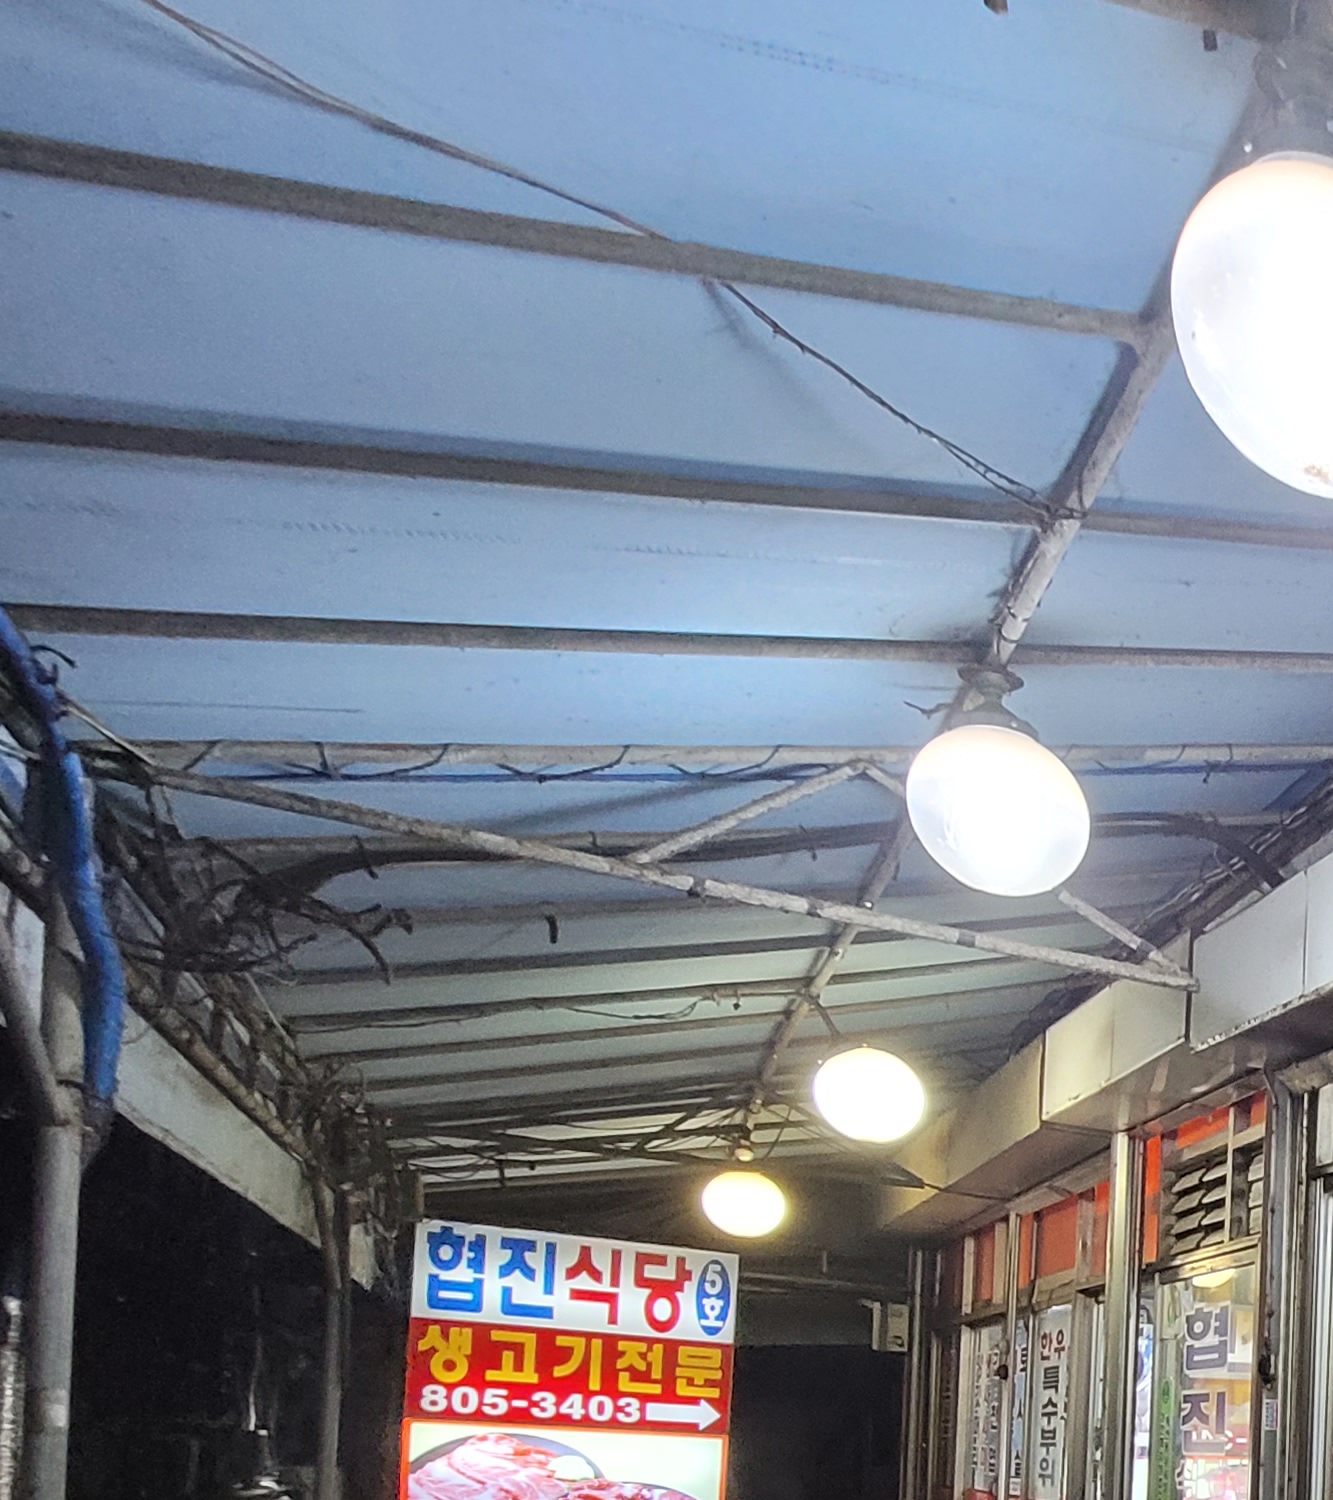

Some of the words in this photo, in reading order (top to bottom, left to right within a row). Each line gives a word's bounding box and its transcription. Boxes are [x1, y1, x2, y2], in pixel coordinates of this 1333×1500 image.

[426, 1226, 693, 1334] 협진식당
[699, 1263, 728, 1329] 5호
[417, 1325, 724, 1399] 생고기전문
[1040, 1328, 1066, 1361] 한우
[1182, 1304, 1230, 1455] 협진
[420, 1385, 641, 1423] 805-3403
[1038, 1365, 1060, 1488] 특수부위
